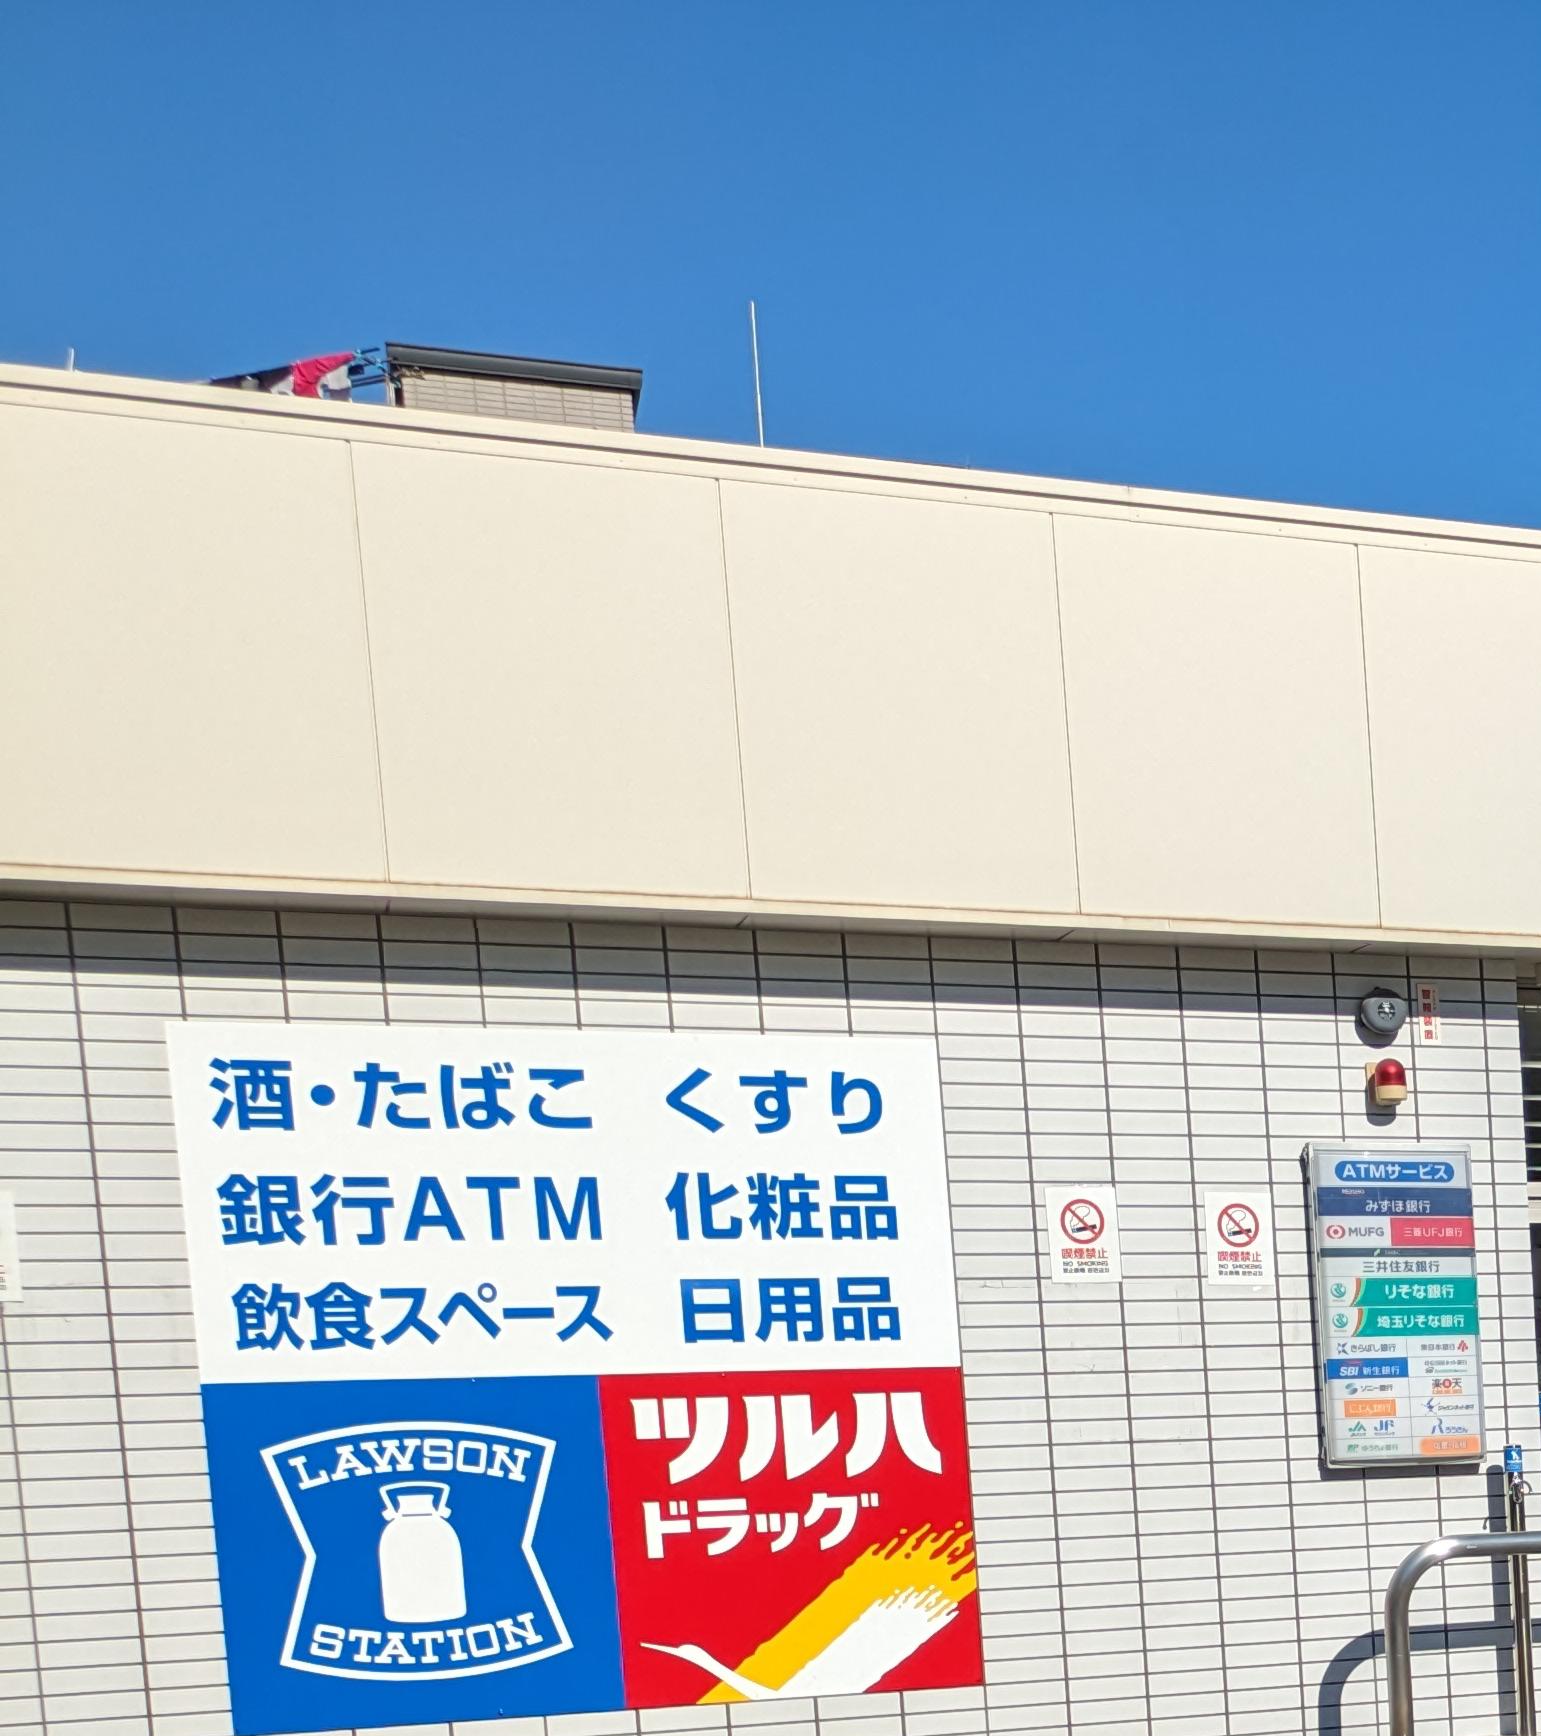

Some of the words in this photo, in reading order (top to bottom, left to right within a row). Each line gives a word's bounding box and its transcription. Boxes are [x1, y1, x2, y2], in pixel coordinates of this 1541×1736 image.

[208, 1057, 594, 1132] 酒・たばこ
[665, 1068, 884, 1136] くすり
[1342, 1163, 1448, 1180] ATMサービス
[217, 1174, 602, 1246] 銀行ATM
[664, 1171, 899, 1242] 化粧品
[1365, 1200, 1431, 1214] みずほ銀行
[1348, 1226, 1384, 1237] MUFG
[1403, 1226, 1463, 1238] 三菱UFJ銀行
[1061, 1248, 1109, 1260] 喫煙禁止
[1217, 1251, 1262, 1263] 喫煙禁止
[1363, 1260, 1440, 1273] 三井住友銀行
[1384, 1283, 1455, 1299] りそな銀行
[231, 1281, 614, 1351] 飲食スペース
[679, 1277, 902, 1344] 日用品
[1377, 1314, 1465, 1328] 埼玉りそな銀行
[1339, 1367, 1359, 1376] SBI
[1362, 1365, 1400, 1376] 新生銀行
[629, 1390, 944, 1485] ツルハ
[287, 1437, 532, 1492] LAWSON
[641, 1491, 881, 1559] ドラッグ
[309, 1609, 545, 1666] STATION
